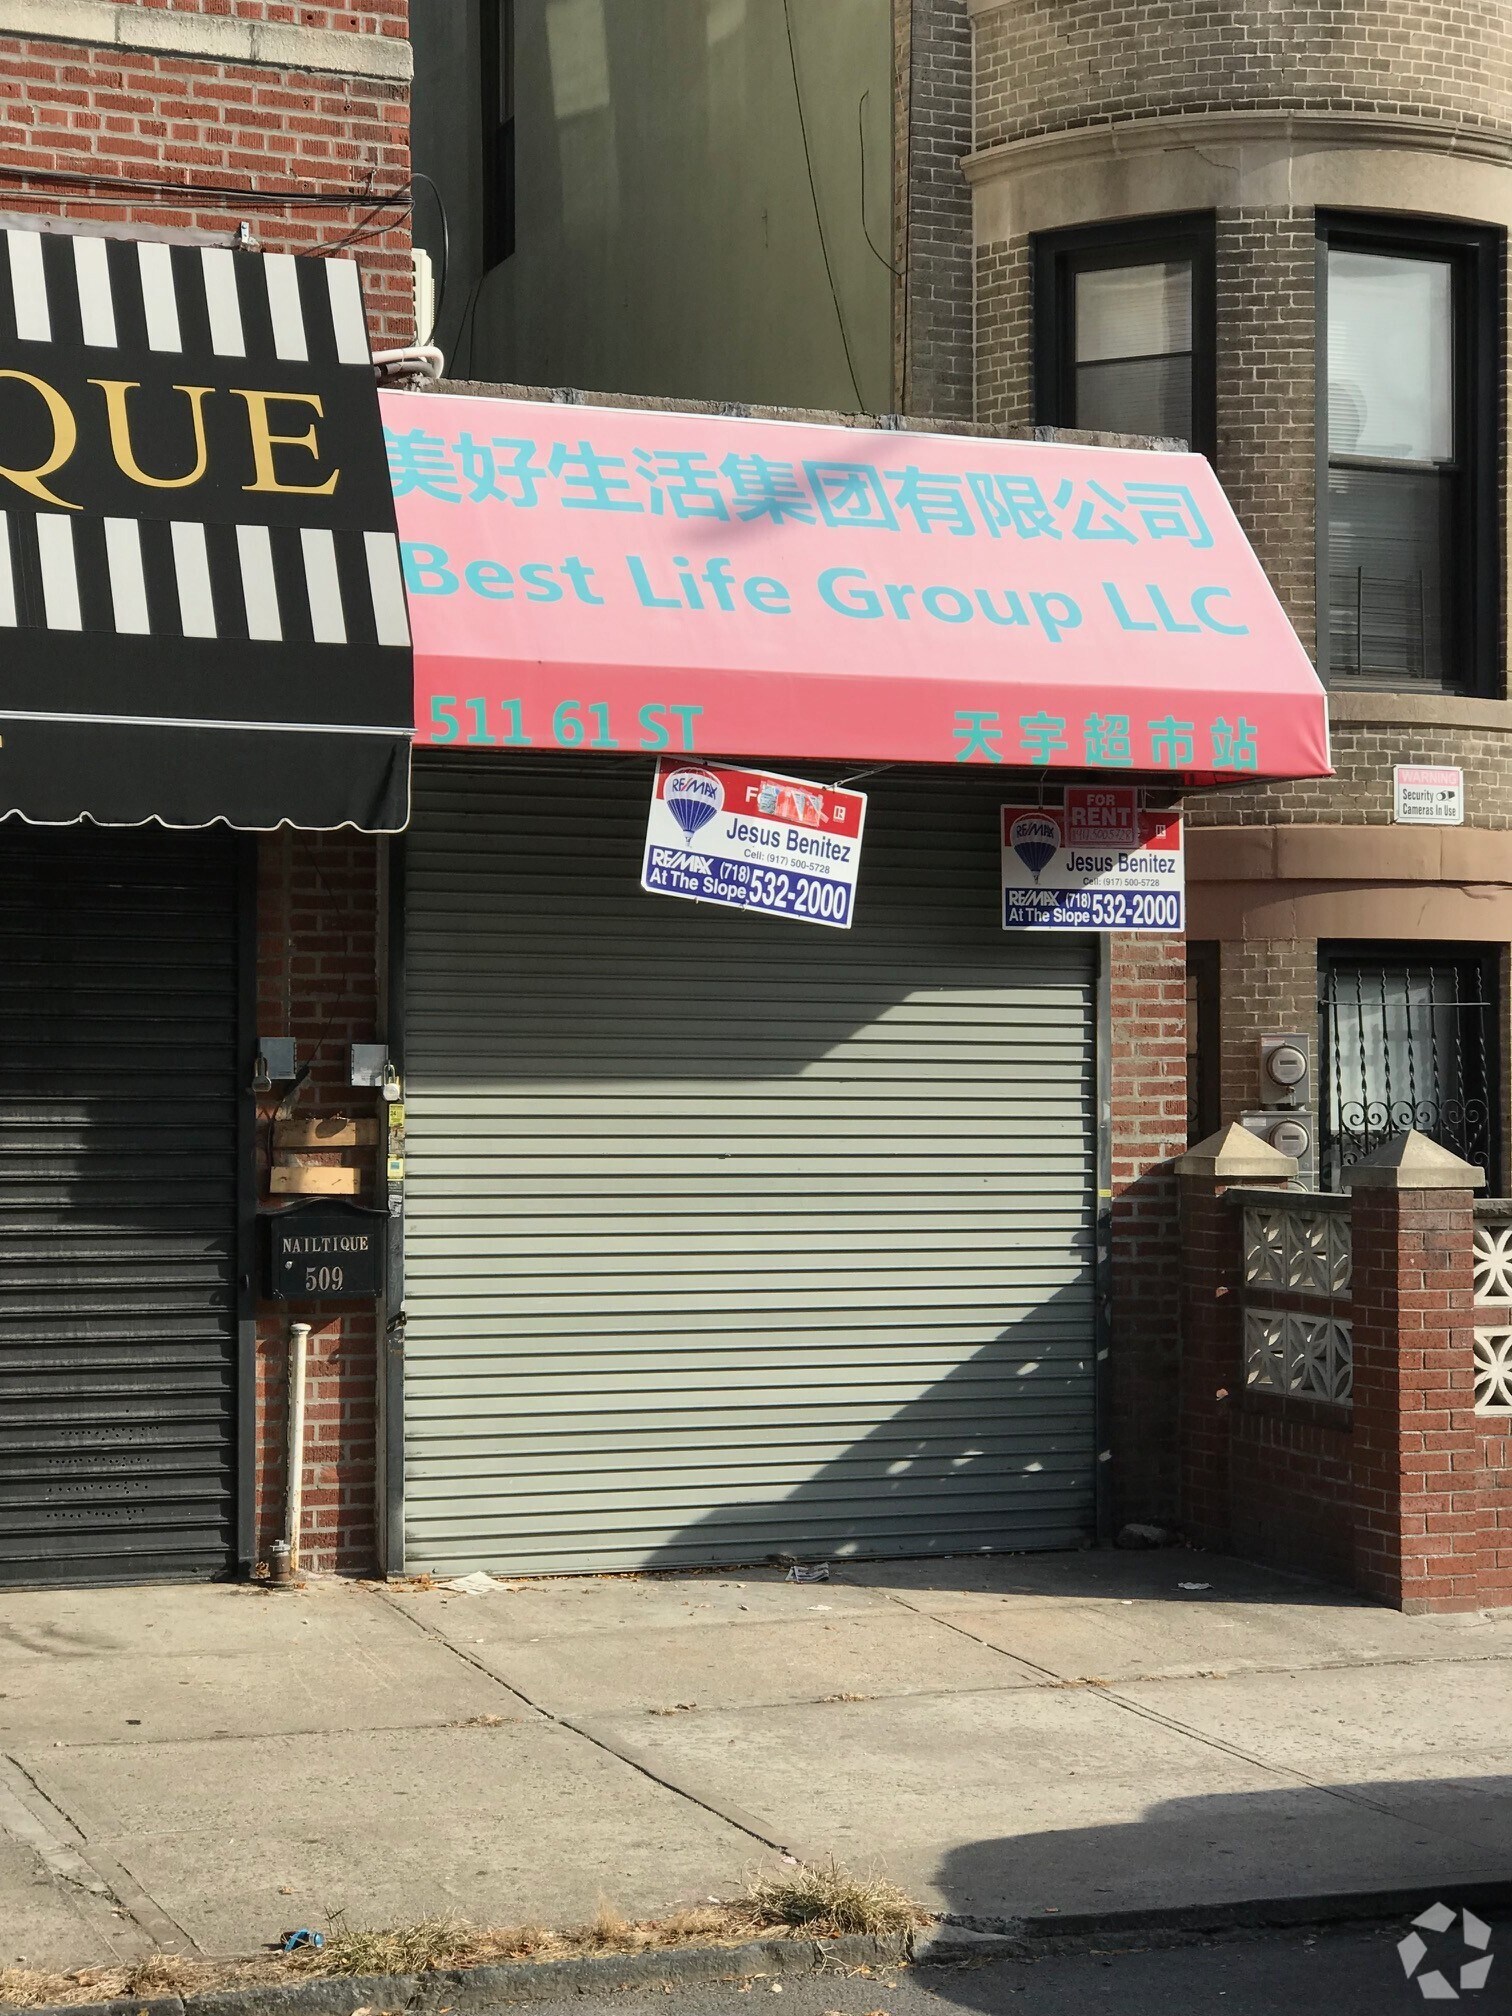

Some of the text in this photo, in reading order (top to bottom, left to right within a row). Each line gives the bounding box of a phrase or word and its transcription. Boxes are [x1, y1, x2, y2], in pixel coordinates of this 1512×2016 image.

[383, 426, 1214, 549] 美好生活集团有限公司
[399, 540, 1250, 643] Best Life Group LLC
[430, 695, 704, 751] 511 61 ST
[952, 710, 1258, 771] 天宇超市站
[1402, 770, 1457, 785] WARNING
[672, 778, 718, 800] RE/MAX
[1087, 794, 1116, 806] FOR
[1402, 788, 1434, 803] Security
[1071, 807, 1131, 827] RENT
[1402, 803, 1456, 816] Cameras In Use
[726, 818, 851, 863] Jesus Benitez
[1016, 823, 1054, 839] RE/MAX
[652, 848, 714, 875] RE/MAX
[744, 848, 830, 874] Cell: (917) 500-5728
[1066, 852, 1176, 874] Jesus Benitez
[650, 867, 747, 900] At The Slope
[720, 861, 847, 920] (718) 532-2000
[1083, 877, 1160, 887] Cell: (917) 500-5728
[1009, 890, 1060, 906] RE/MAX
[1065, 892, 1178, 926] (718) 532-2000
[1009, 908, 1090, 926] At The Slope
[282, 1236, 369, 1253] NAILTIQUE
[305, 1266, 344, 1291] 509
